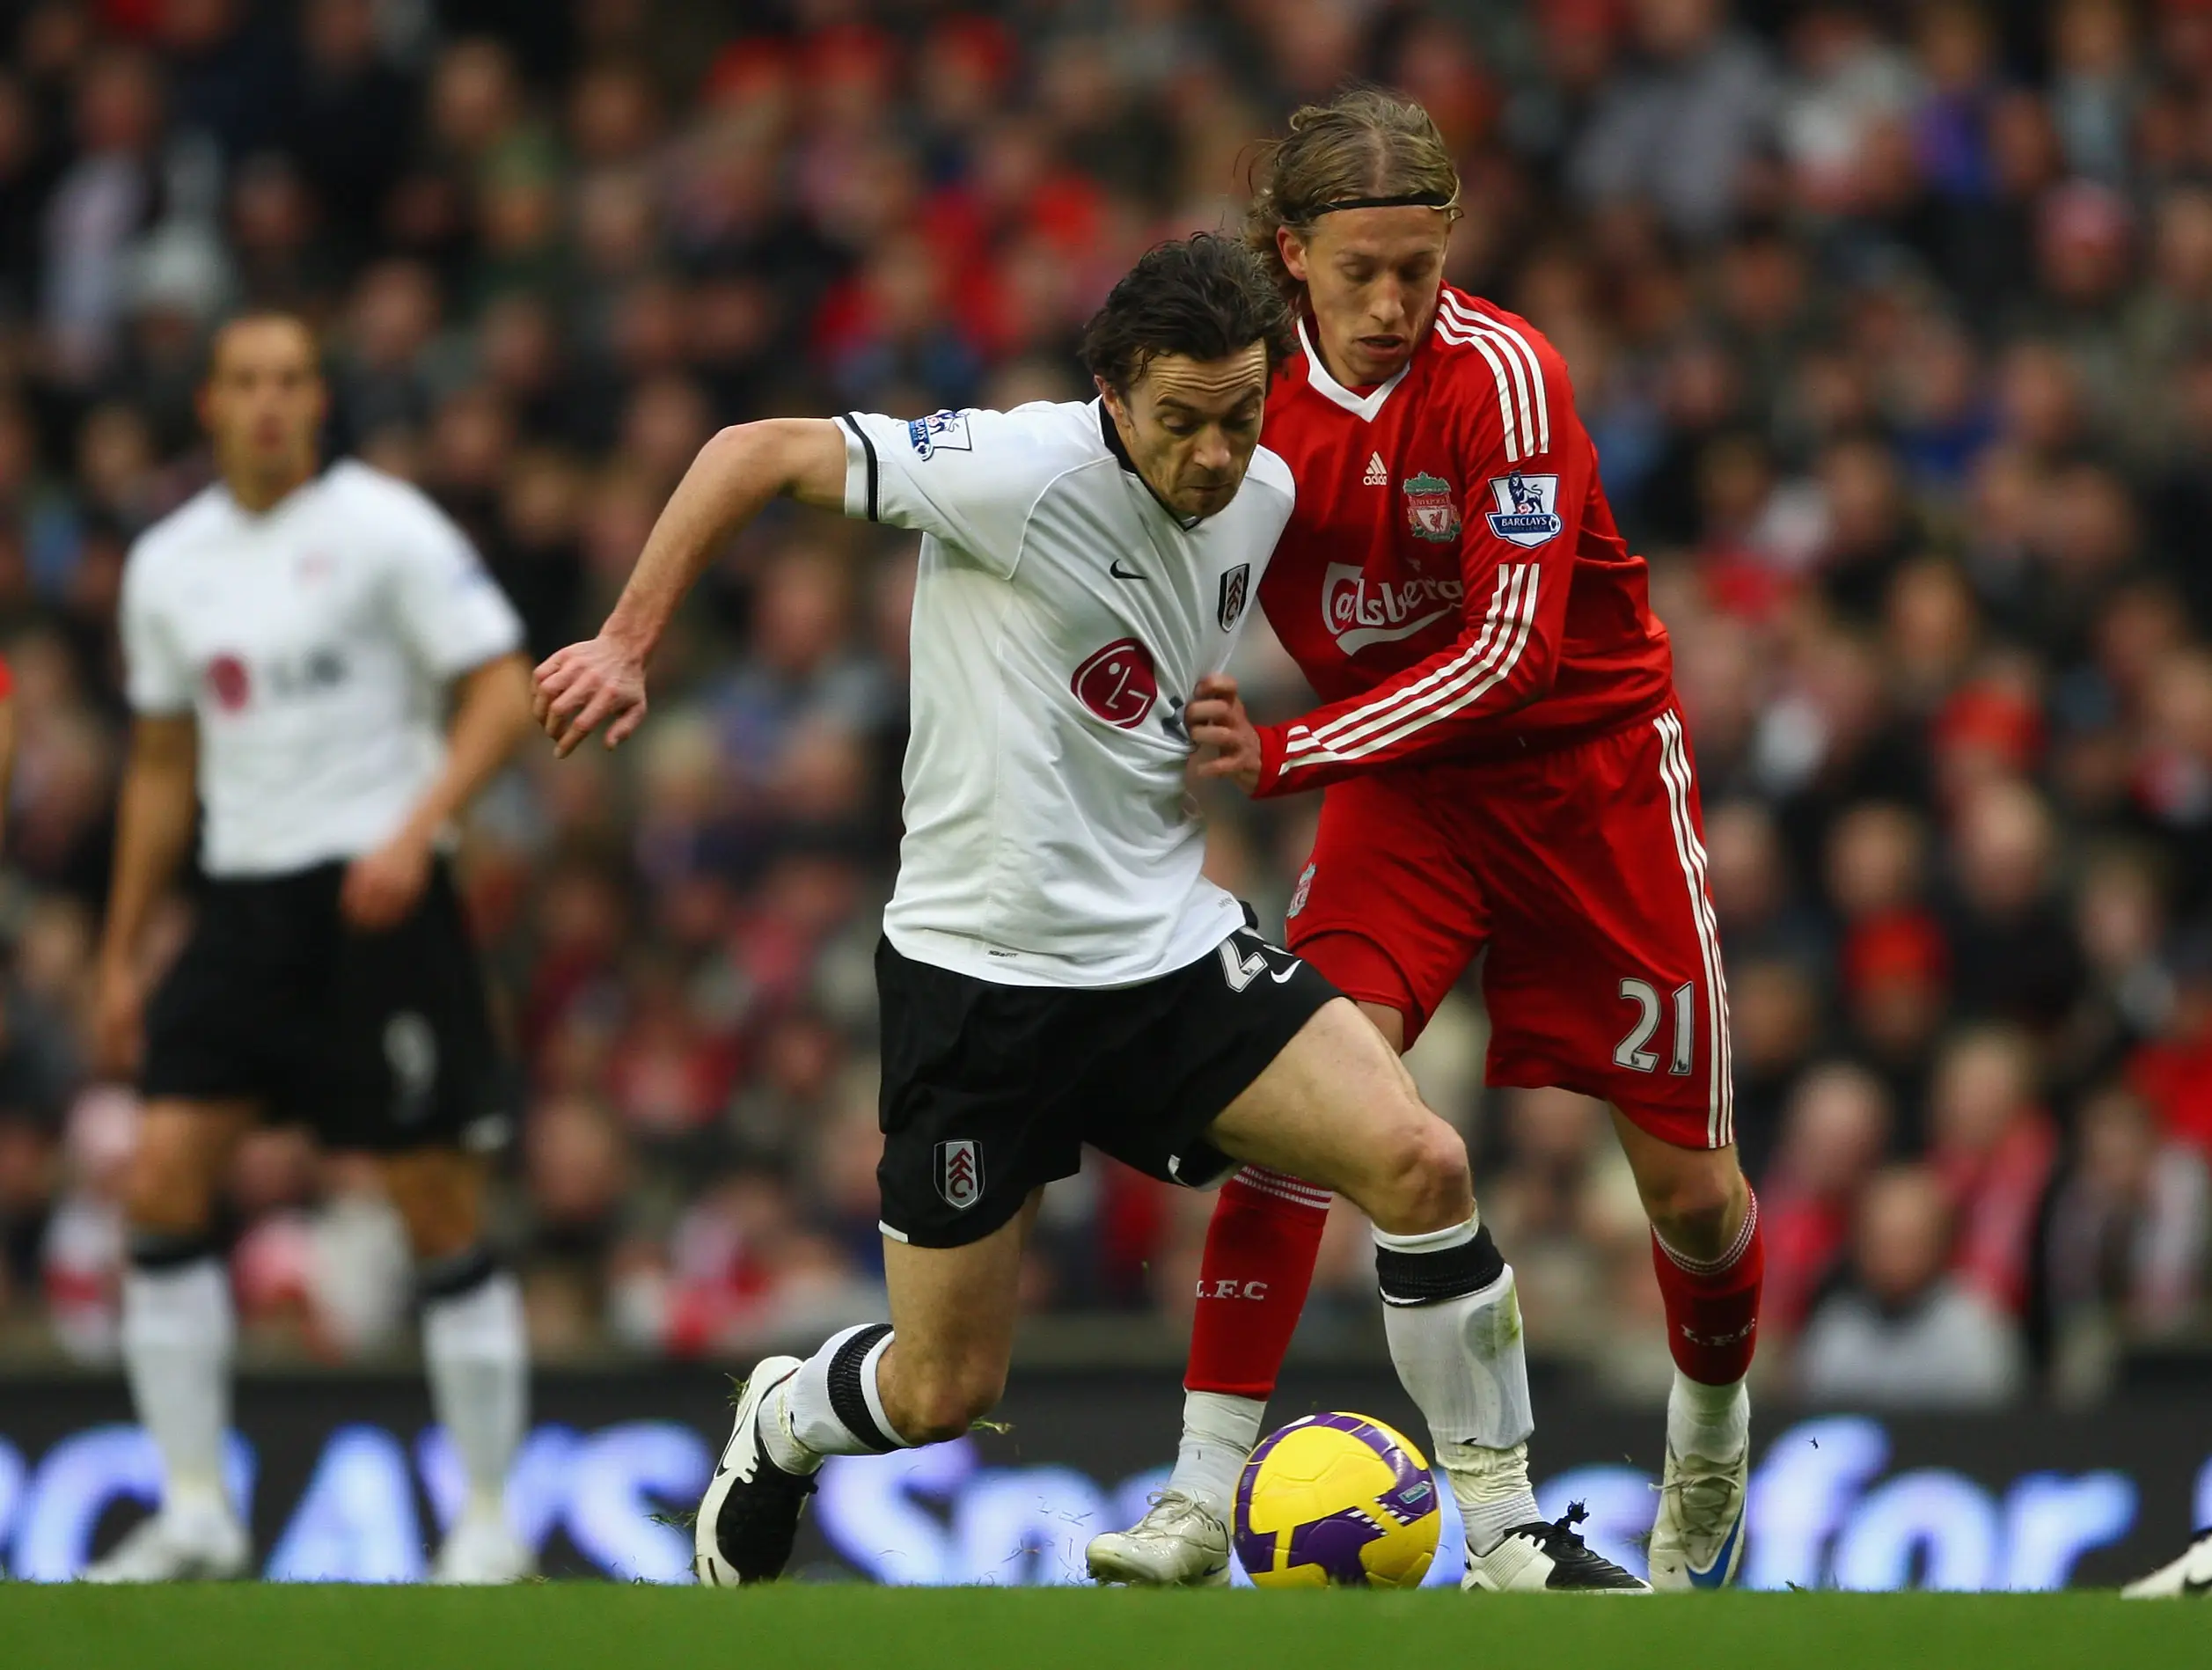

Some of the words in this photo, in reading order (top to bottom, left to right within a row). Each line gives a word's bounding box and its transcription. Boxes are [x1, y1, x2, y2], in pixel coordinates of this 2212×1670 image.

[1501, 516, 1548, 527] BARCLAYS
[1613, 977, 1694, 1075] 21
[1749, 1414, 2142, 1589] for
